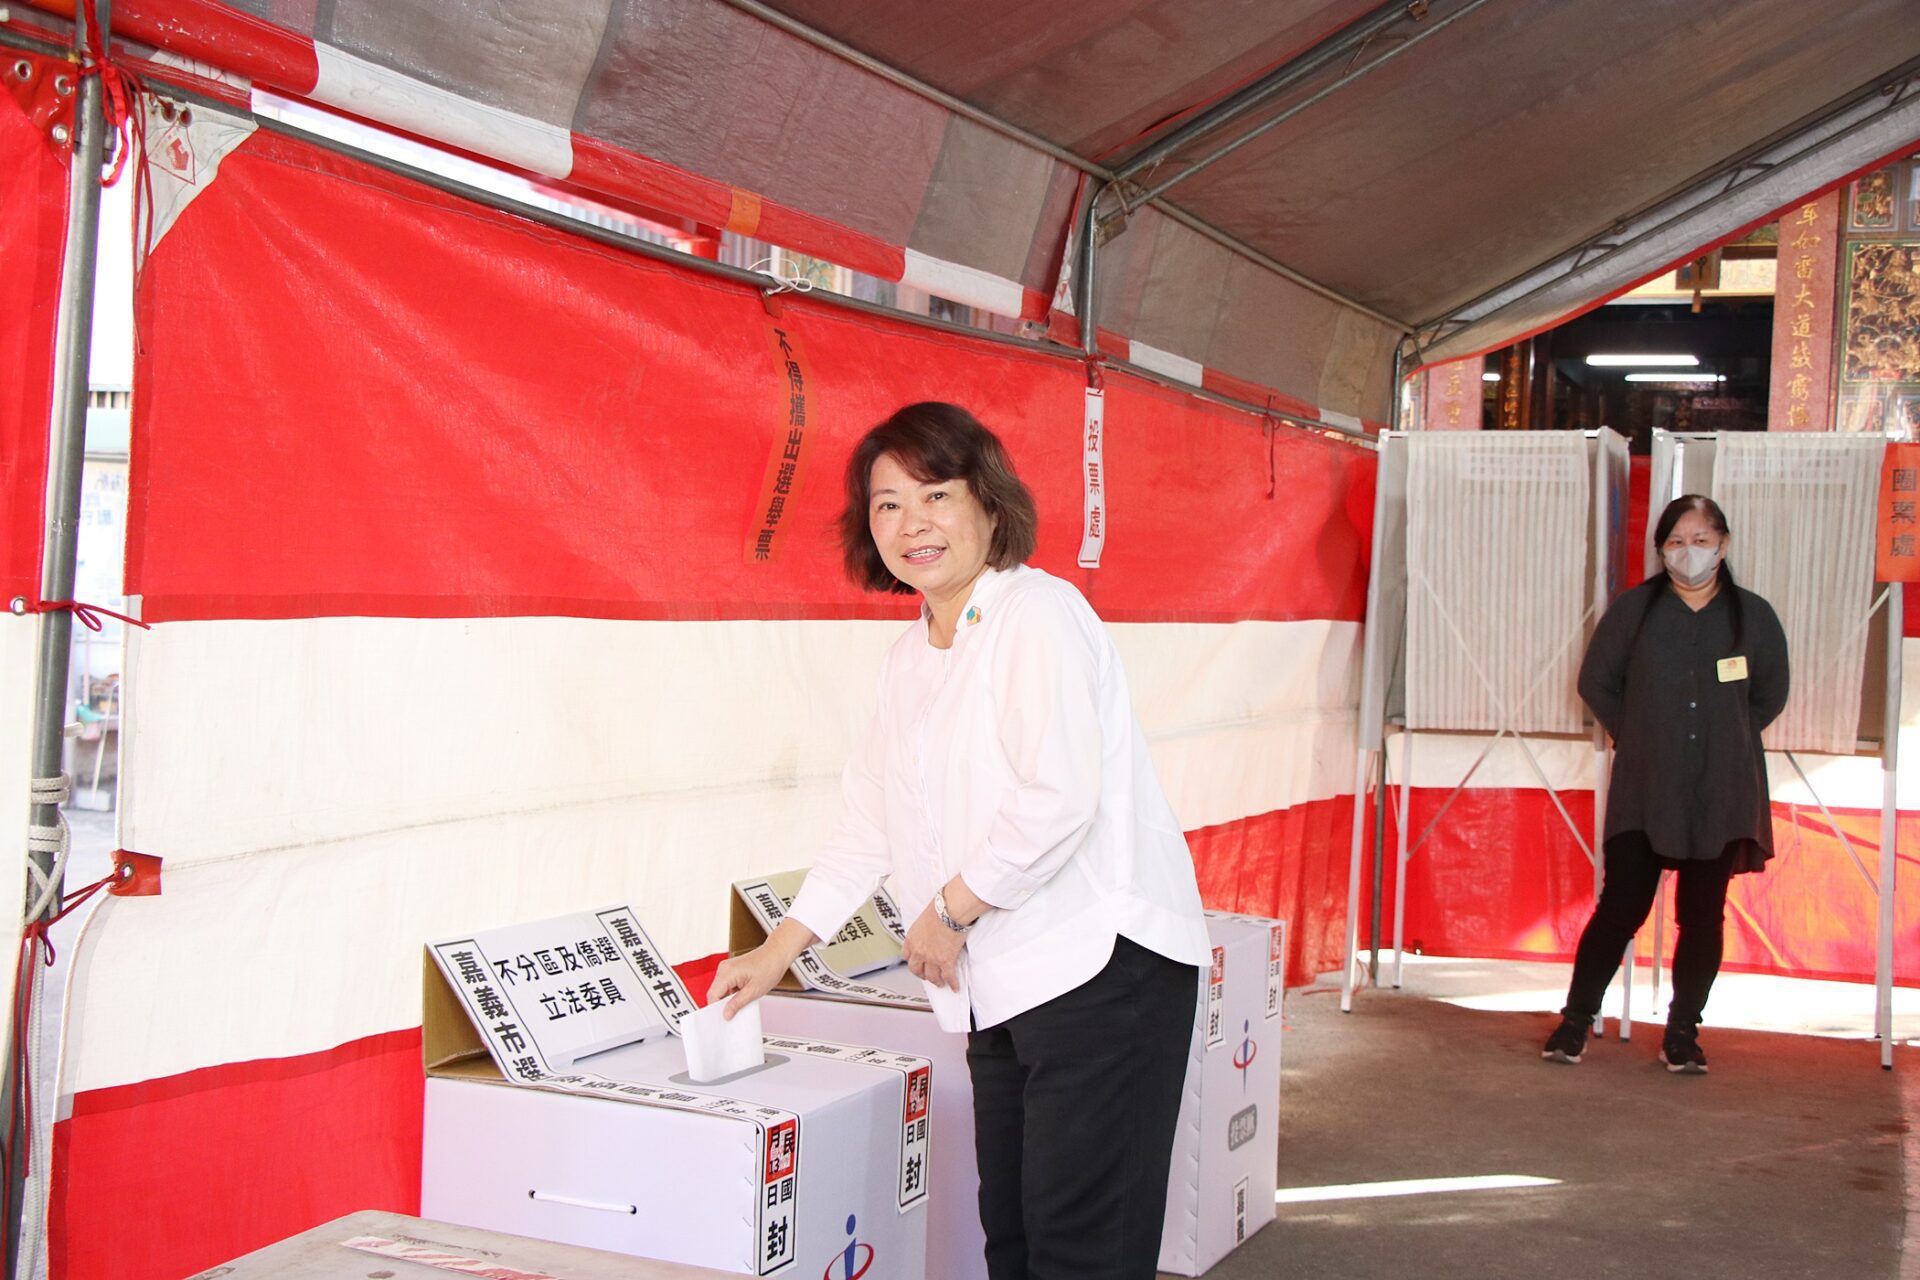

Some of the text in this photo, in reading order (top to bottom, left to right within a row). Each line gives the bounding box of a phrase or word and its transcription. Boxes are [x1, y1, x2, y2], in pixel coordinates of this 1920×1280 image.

[754, 327, 806, 561] 不得攜出選舉票
[1889, 468, 1918, 557] 圈票處
[492, 936, 622, 987] 不分區及僑選
[539, 977, 627, 1021] 立法委員
[904, 1152, 922, 1193] 封
[766, 1215, 788, 1262] 封
